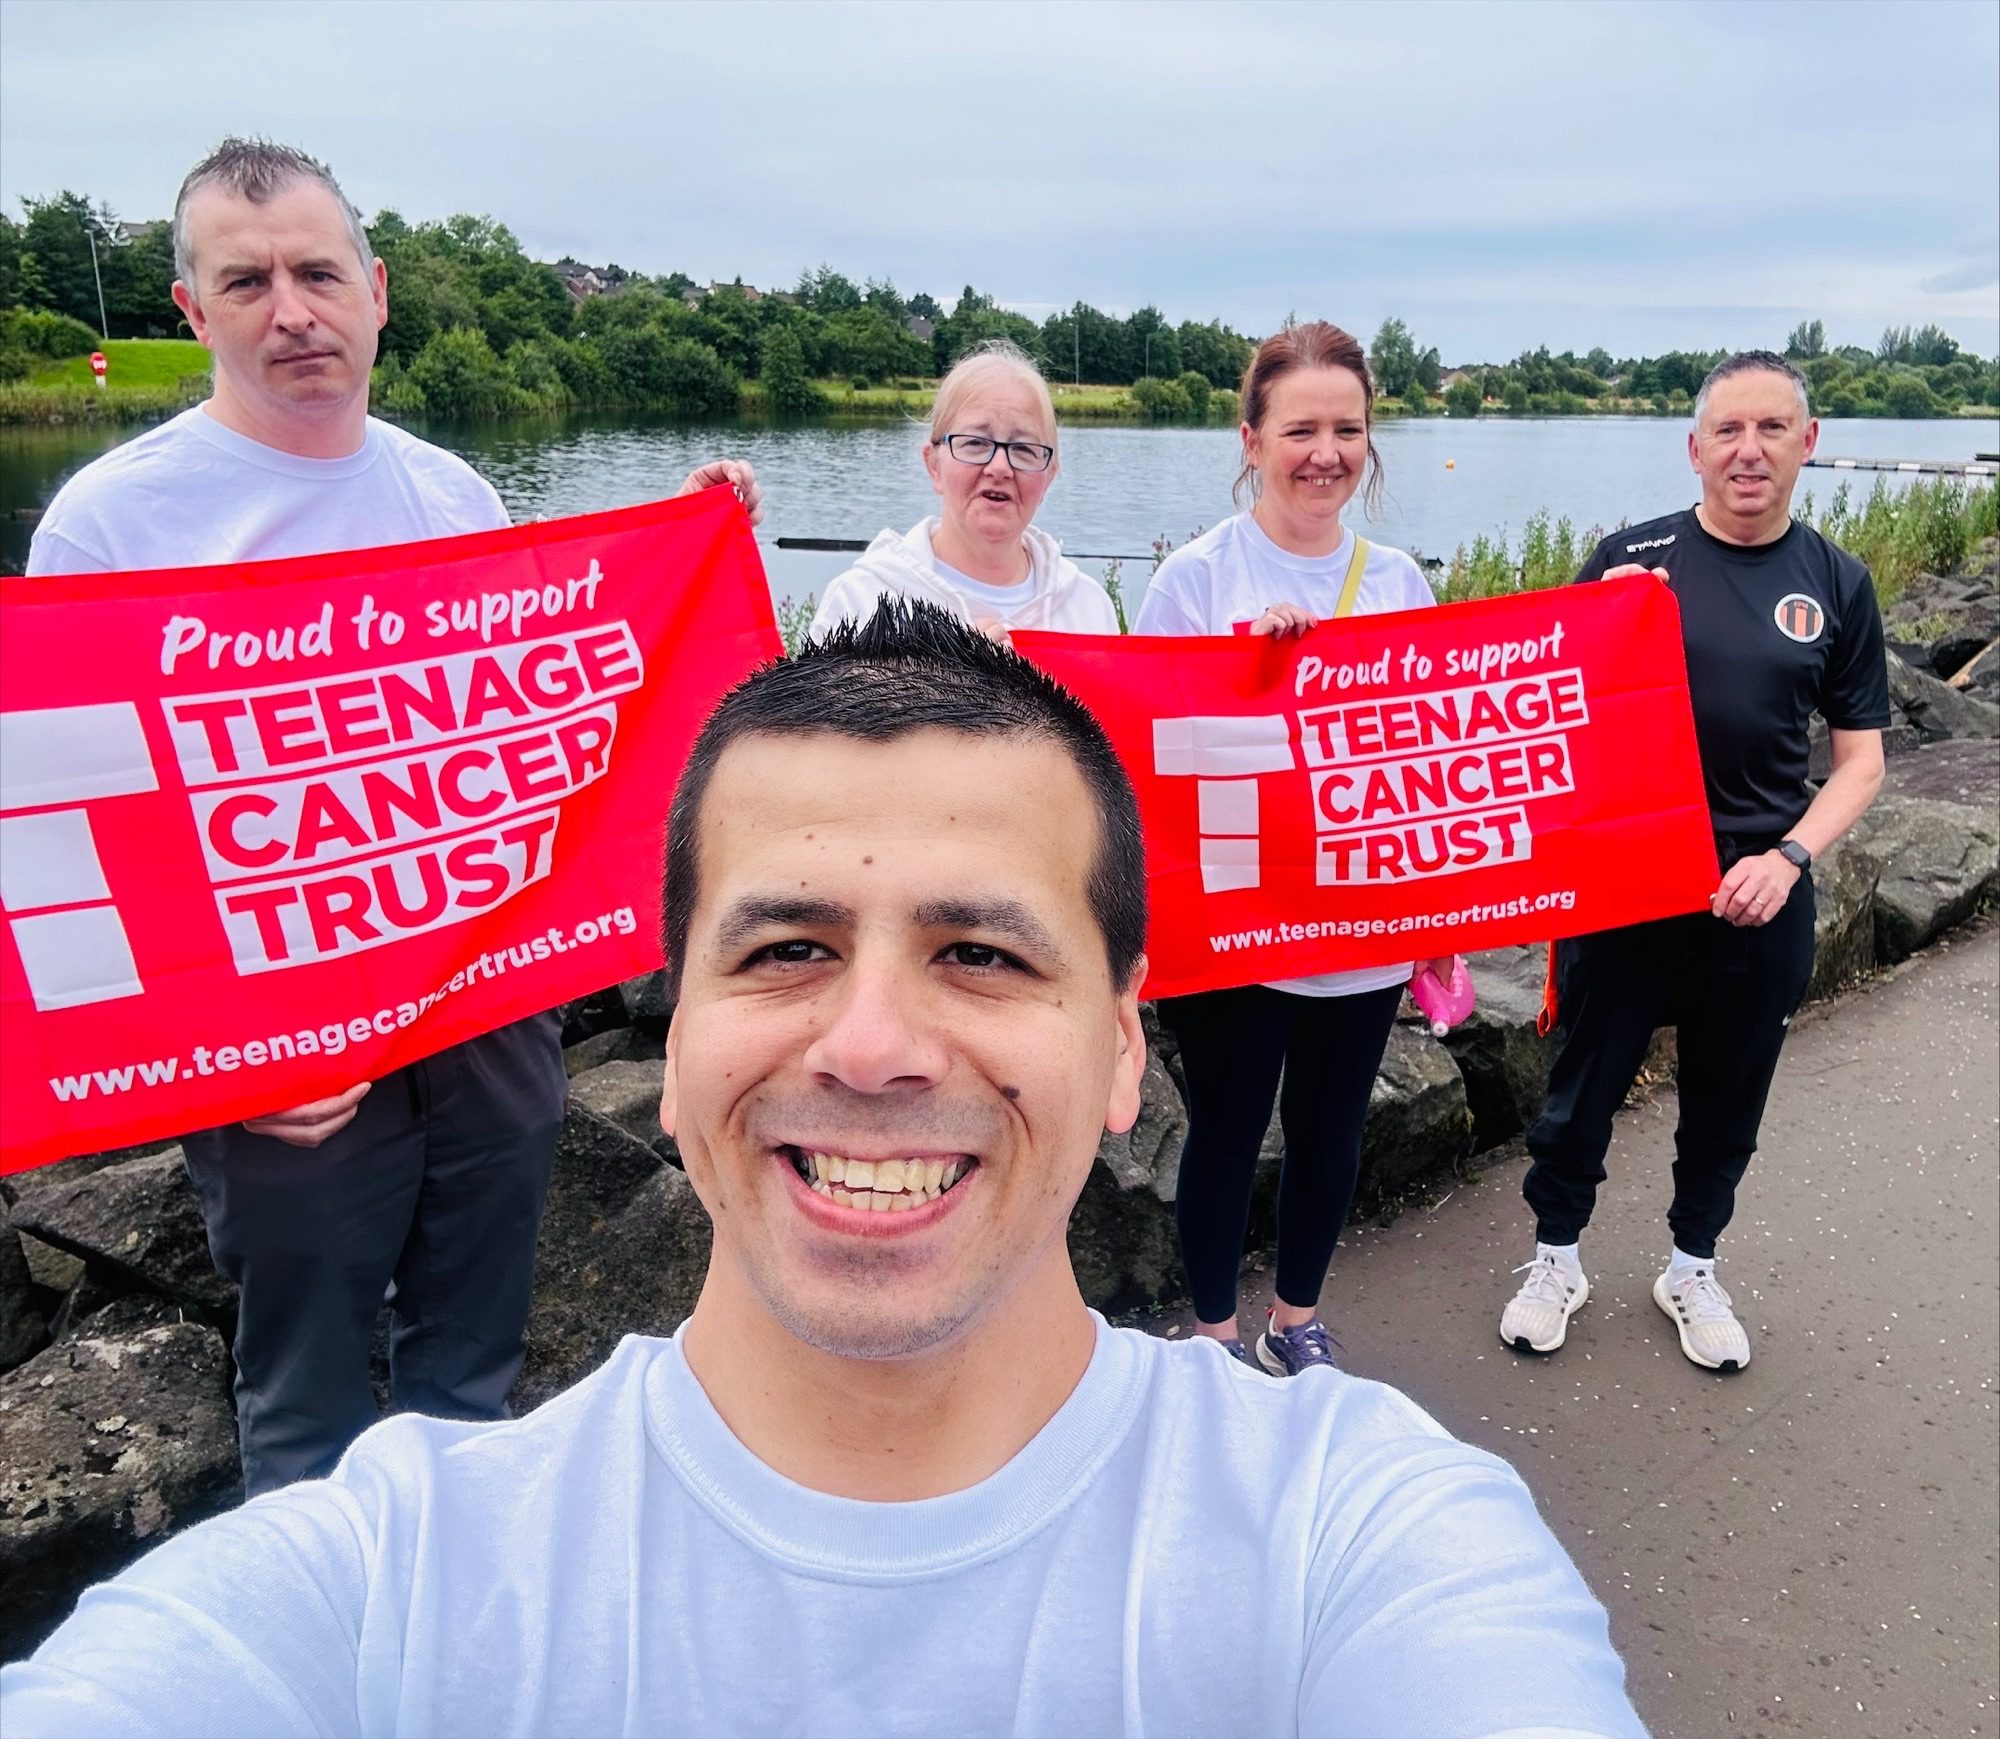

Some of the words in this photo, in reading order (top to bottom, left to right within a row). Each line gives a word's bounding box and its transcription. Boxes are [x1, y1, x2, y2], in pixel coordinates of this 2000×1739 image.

[1626, 534, 1676, 553] STANNO
[160, 602, 334, 675] Proud
[351, 595, 404, 650] to
[425, 558, 604, 637] support
[1295, 648, 1391, 697] Proud
[1400, 643, 1433, 682] to
[1445, 621, 1565, 681] support
[176, 628, 640, 774] TEENAGE
[1303, 673, 1585, 760] TEENAGE
[207, 716, 613, 869] CANCER
[1318, 742, 1570, 825] CANCER
[225, 815, 556, 962] TRUST
[1321, 811, 1522, 881] TRUST
[1209, 888, 1576, 953] www.teenagecancertrust.org
[49, 906, 637, 1102] www.teenagecancertrust.org
